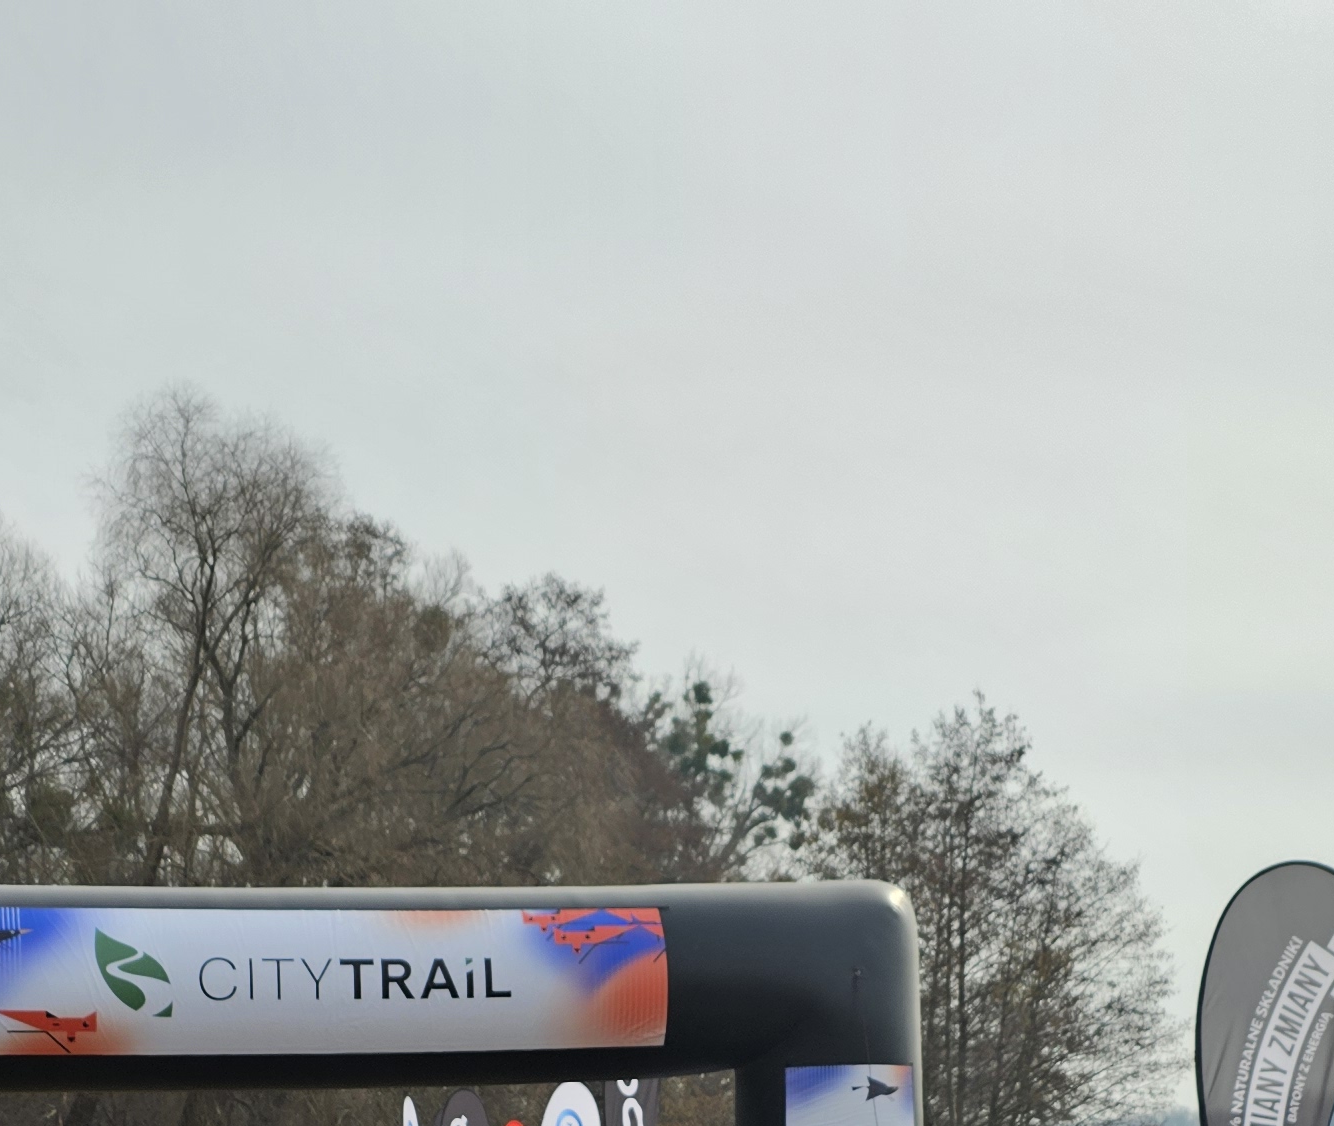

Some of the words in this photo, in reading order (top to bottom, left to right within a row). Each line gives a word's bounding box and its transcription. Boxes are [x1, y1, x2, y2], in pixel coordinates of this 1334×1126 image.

[1230, 1016, 1265, 1114] NATURALNE
[1257, 934, 1305, 1019] SKŁADNIKI
[1267, 952, 1331, 1057] ZMIANY
[1304, 1010, 1334, 1063] ENERGIĄ
[1301, 1060, 1311, 1074] Z
[1286, 1074, 1307, 1124] BATONY
